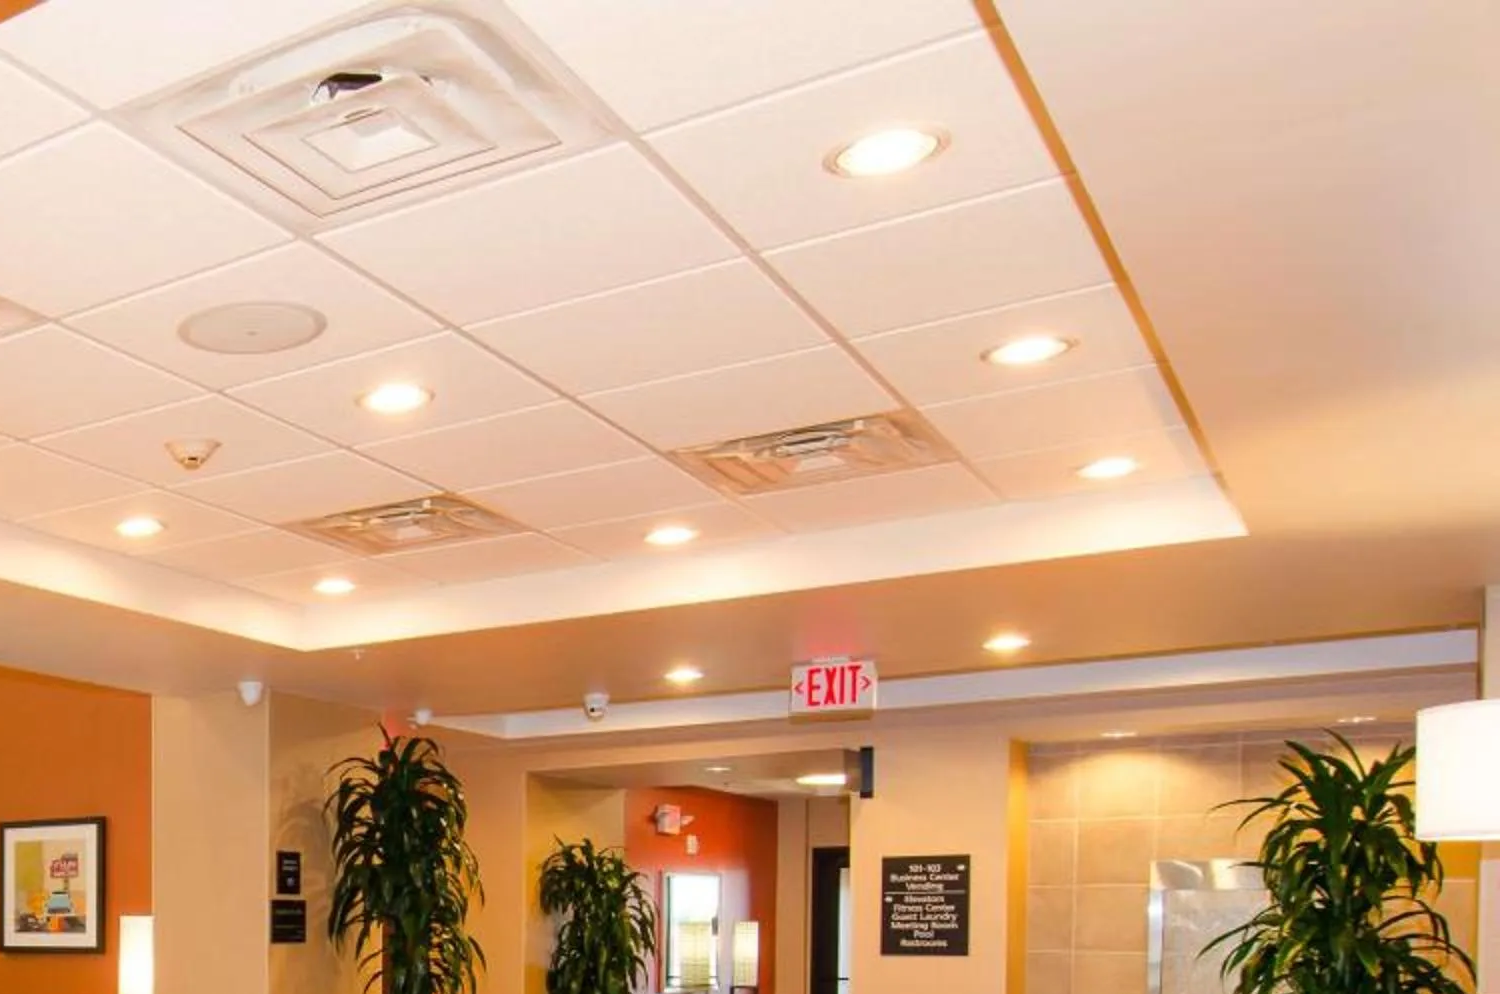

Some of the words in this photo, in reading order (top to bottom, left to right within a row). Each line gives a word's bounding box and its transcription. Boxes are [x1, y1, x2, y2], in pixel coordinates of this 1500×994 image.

[807, 665, 862, 707] EXIT
[890, 873, 927, 883] Business
[929, 872, 959, 881] Center
[905, 882, 944, 892] Vending
[904, 895, 945, 903] Elevators
[893, 904, 923, 912] Fitness
[925, 903, 955, 912] Center
[891, 912, 918, 921] Guest
[919, 912, 958, 923] Laundry
[890, 921, 929, 931] Meeting
[931, 921, 959, 929] Room
[913, 930, 935, 939] Pool
[900, 939, 948, 948] Restrooms
